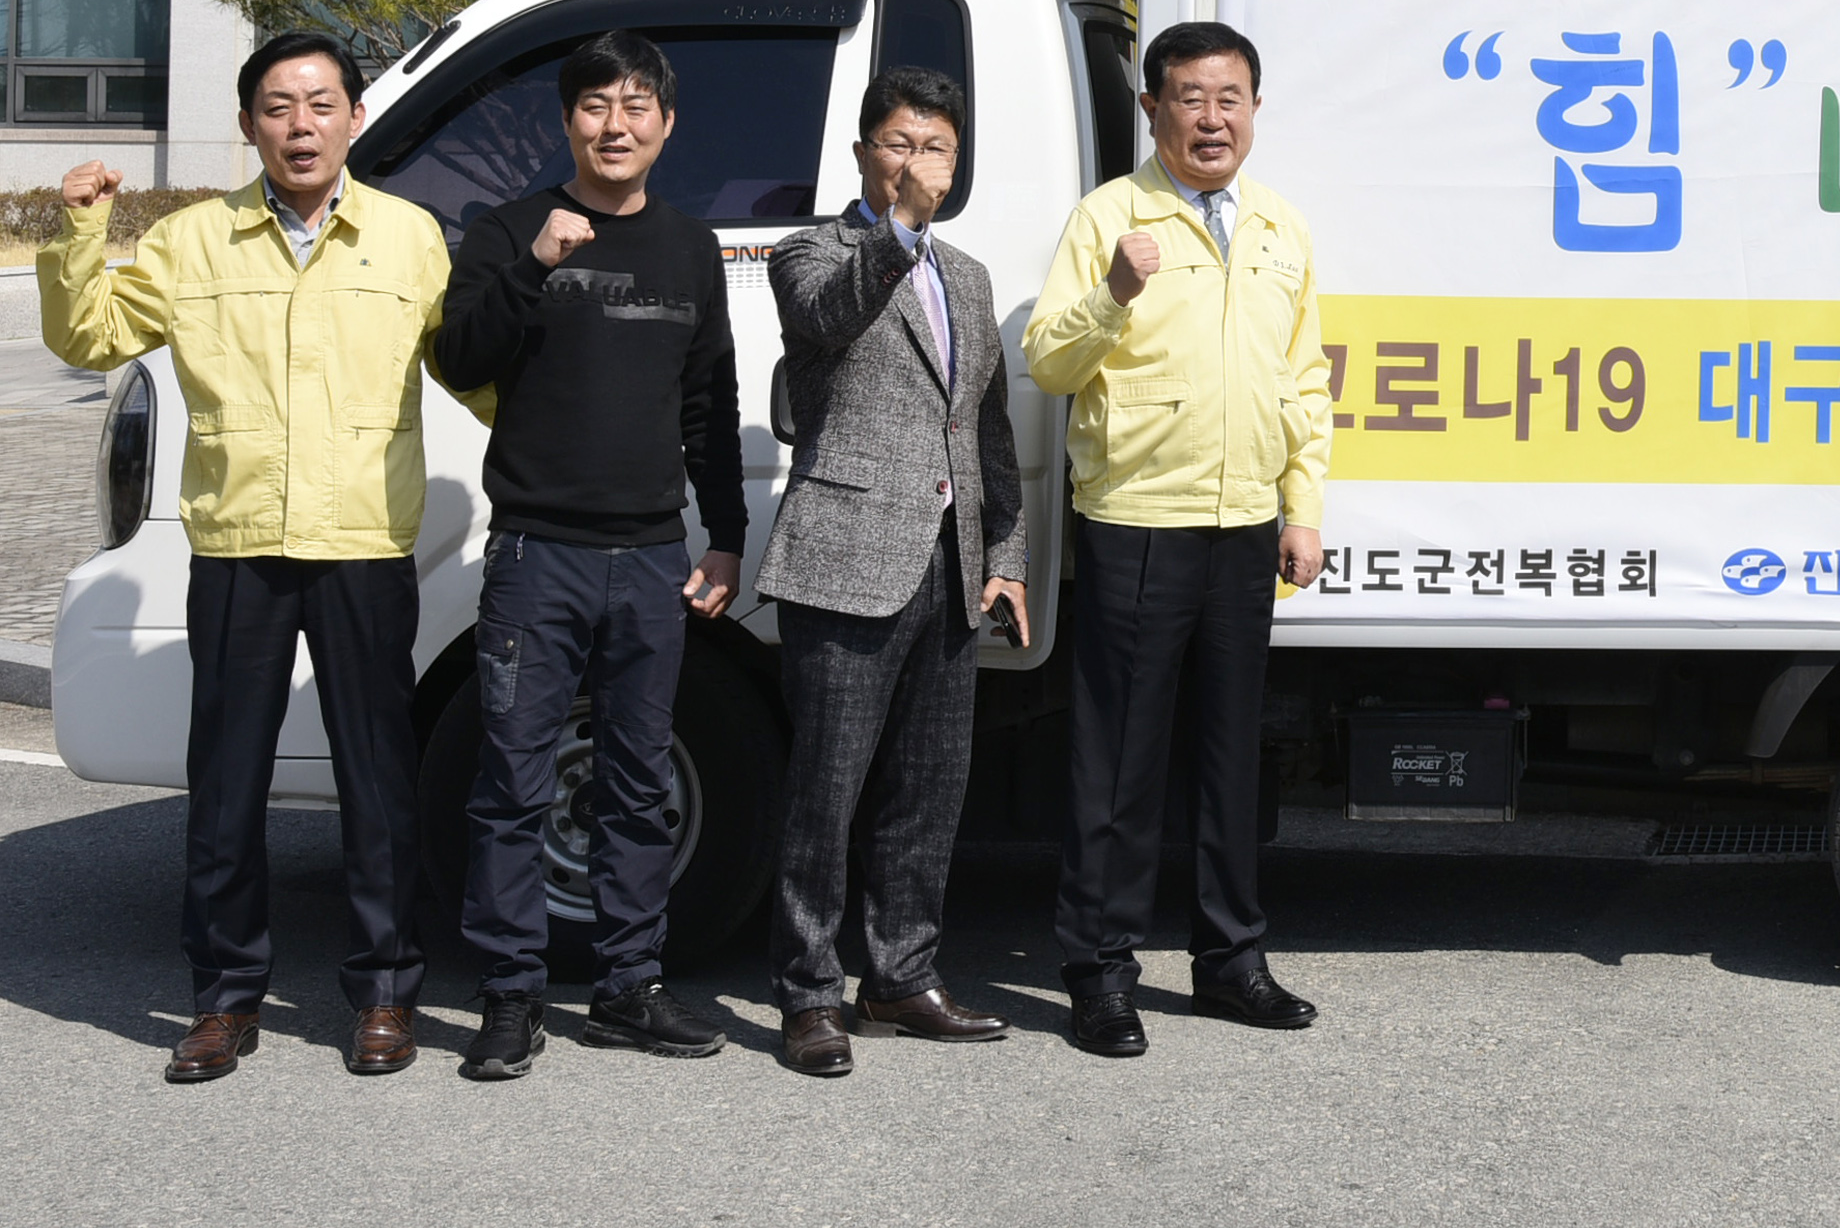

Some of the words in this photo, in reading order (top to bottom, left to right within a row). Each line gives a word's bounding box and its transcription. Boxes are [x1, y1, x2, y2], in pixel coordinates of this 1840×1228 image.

[1319, 546, 1658, 598] 진도군전복협회
[1393, 757, 1443, 770] ROCKET
[1449, 775, 1464, 787] Pb
